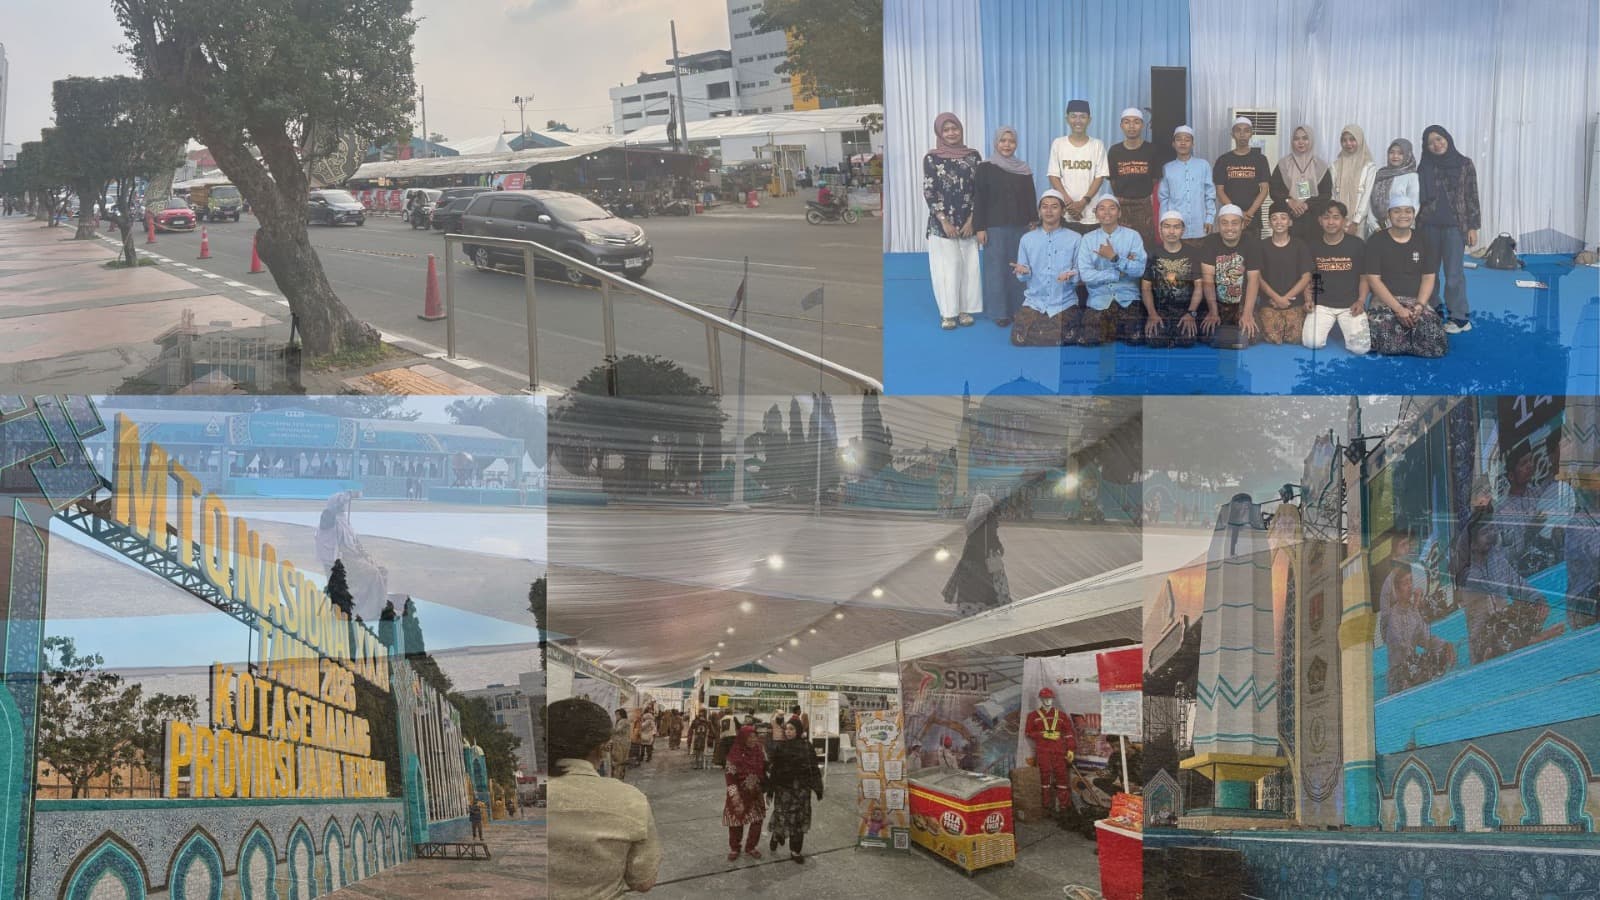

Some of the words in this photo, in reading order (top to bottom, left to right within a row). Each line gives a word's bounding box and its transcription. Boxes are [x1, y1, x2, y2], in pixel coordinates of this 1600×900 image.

[1062, 160, 1092, 170] PLOSO
[111, 411, 232, 599] MTQ
[233, 516, 360, 672] NASIONAL
[209, 661, 287, 740] KOTA
[287, 690, 371, 757] SEMARANG
[944, 670, 989, 691] SPJT
[163, 720, 297, 798] PROVINSI
[297, 745, 343, 798] JAWA
